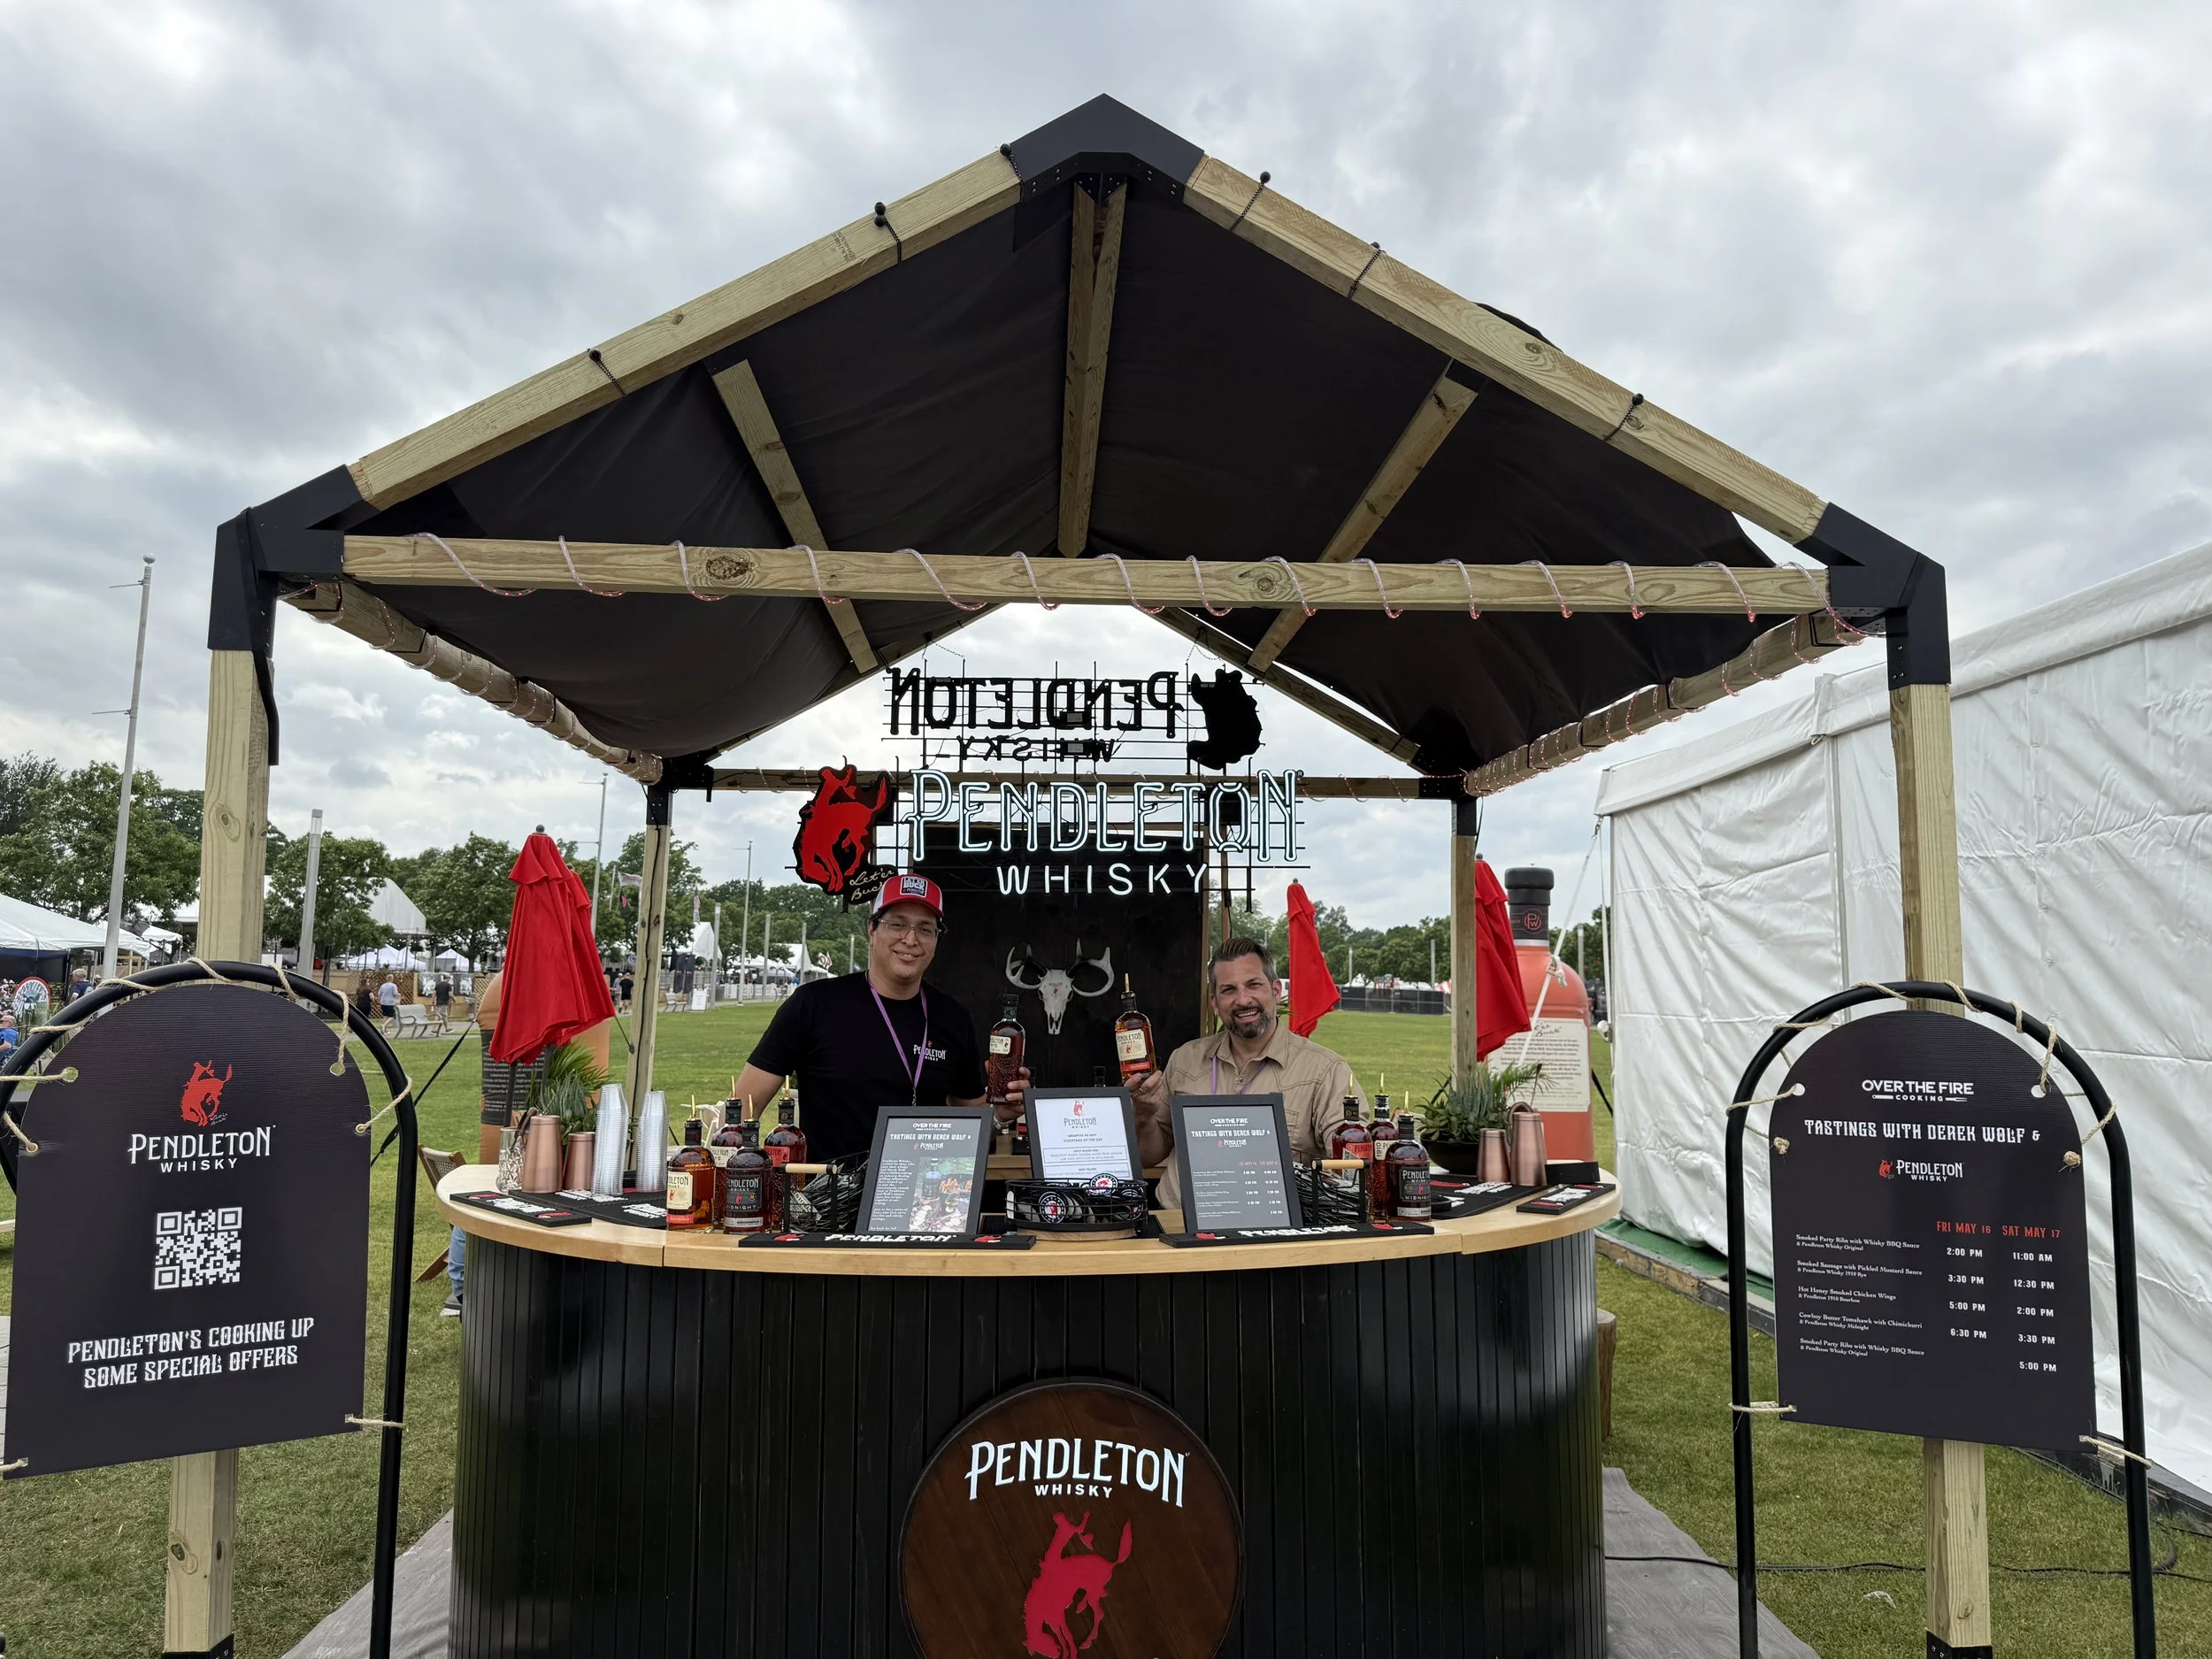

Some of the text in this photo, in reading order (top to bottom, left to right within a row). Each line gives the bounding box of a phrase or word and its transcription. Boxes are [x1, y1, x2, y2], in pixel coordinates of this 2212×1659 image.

[902, 768, 1297, 862] PENDLETON
[849, 868, 895, 886] Let'er
[996, 863, 1209, 895] WHISKY
[913, 1044, 946, 1060] PEDLETON
[1862, 1079, 1974, 1094] OVER THE FIRE
[1804, 1119, 2040, 1143] TASTINGS WITH DEREK WOLF &
[127, 1126, 271, 1164] PENDLETON
[160, 1157, 238, 1173] WHISKY
[1896, 1159, 1962, 1178] PENDLETON
[727, 1177, 759, 1188] ENDLETON
[1936, 1221, 1992, 1234] FRI MAY 16
[2002, 1225, 2061, 1238] SAT MAY 17
[1947, 1247, 1983, 1257] 2:00 PM
[2013, 1252, 2034, 1261] 11:00
[1948, 1274, 1984, 1285] 3:30 PM
[2014, 1279, 2055, 1290] 12:30 PM
[1810, 1286, 1828, 1295] Honey
[1949, 1301, 1985, 1311] 5:00 PM
[2016, 1306, 2036, 1316] 2:00
[1842, 1316, 1872, 1325] Tomahawk
[68, 1317, 314, 1363] PENDLETON'S COOKING UP
[1950, 1328, 1987, 1339] 6:30 PM
[2018, 1333, 2037, 1343] 3:30
[1868, 1344, 1889, 1353] Whisky
[84, 1345, 298, 1389] SOME SPECIAL OFFERS
[2019, 1361, 2056, 1371] 5:00 PM
[964, 1438, 1183, 1508] PENDLETON
[1034, 1483, 1113, 1499] WHISKY
